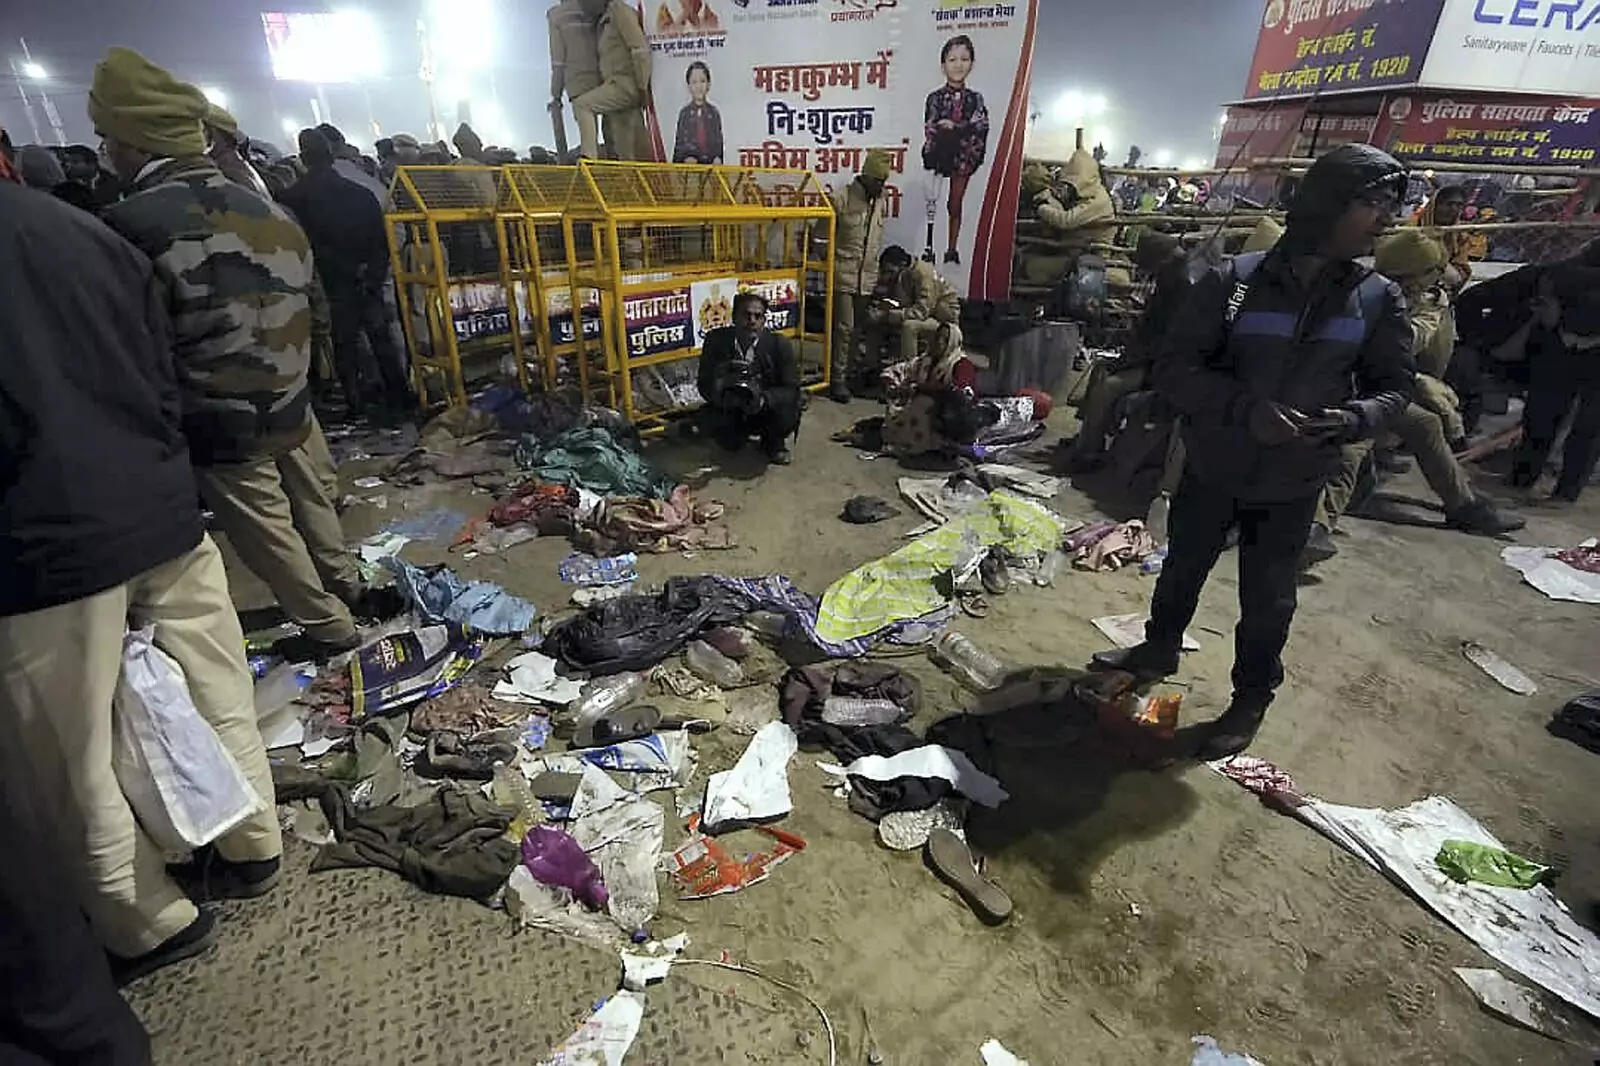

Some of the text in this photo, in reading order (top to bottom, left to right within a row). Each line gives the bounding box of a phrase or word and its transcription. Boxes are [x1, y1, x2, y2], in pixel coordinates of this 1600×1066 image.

[1462, 34, 1528, 54] Sanitaryware
[1537, 40, 1574, 56] Faucets
[753, 48, 893, 101] महाकुम्भ में
[1370, 56, 1411, 79] 1920
[1421, 101, 1476, 123] पुलिस
[1481, 103, 1552, 122] सहायता
[815, 138, 862, 173] अंग
[866, 137, 909, 174] वं
[1550, 148, 1596, 160] 1920
[631, 325, 686, 355] पुलिस
